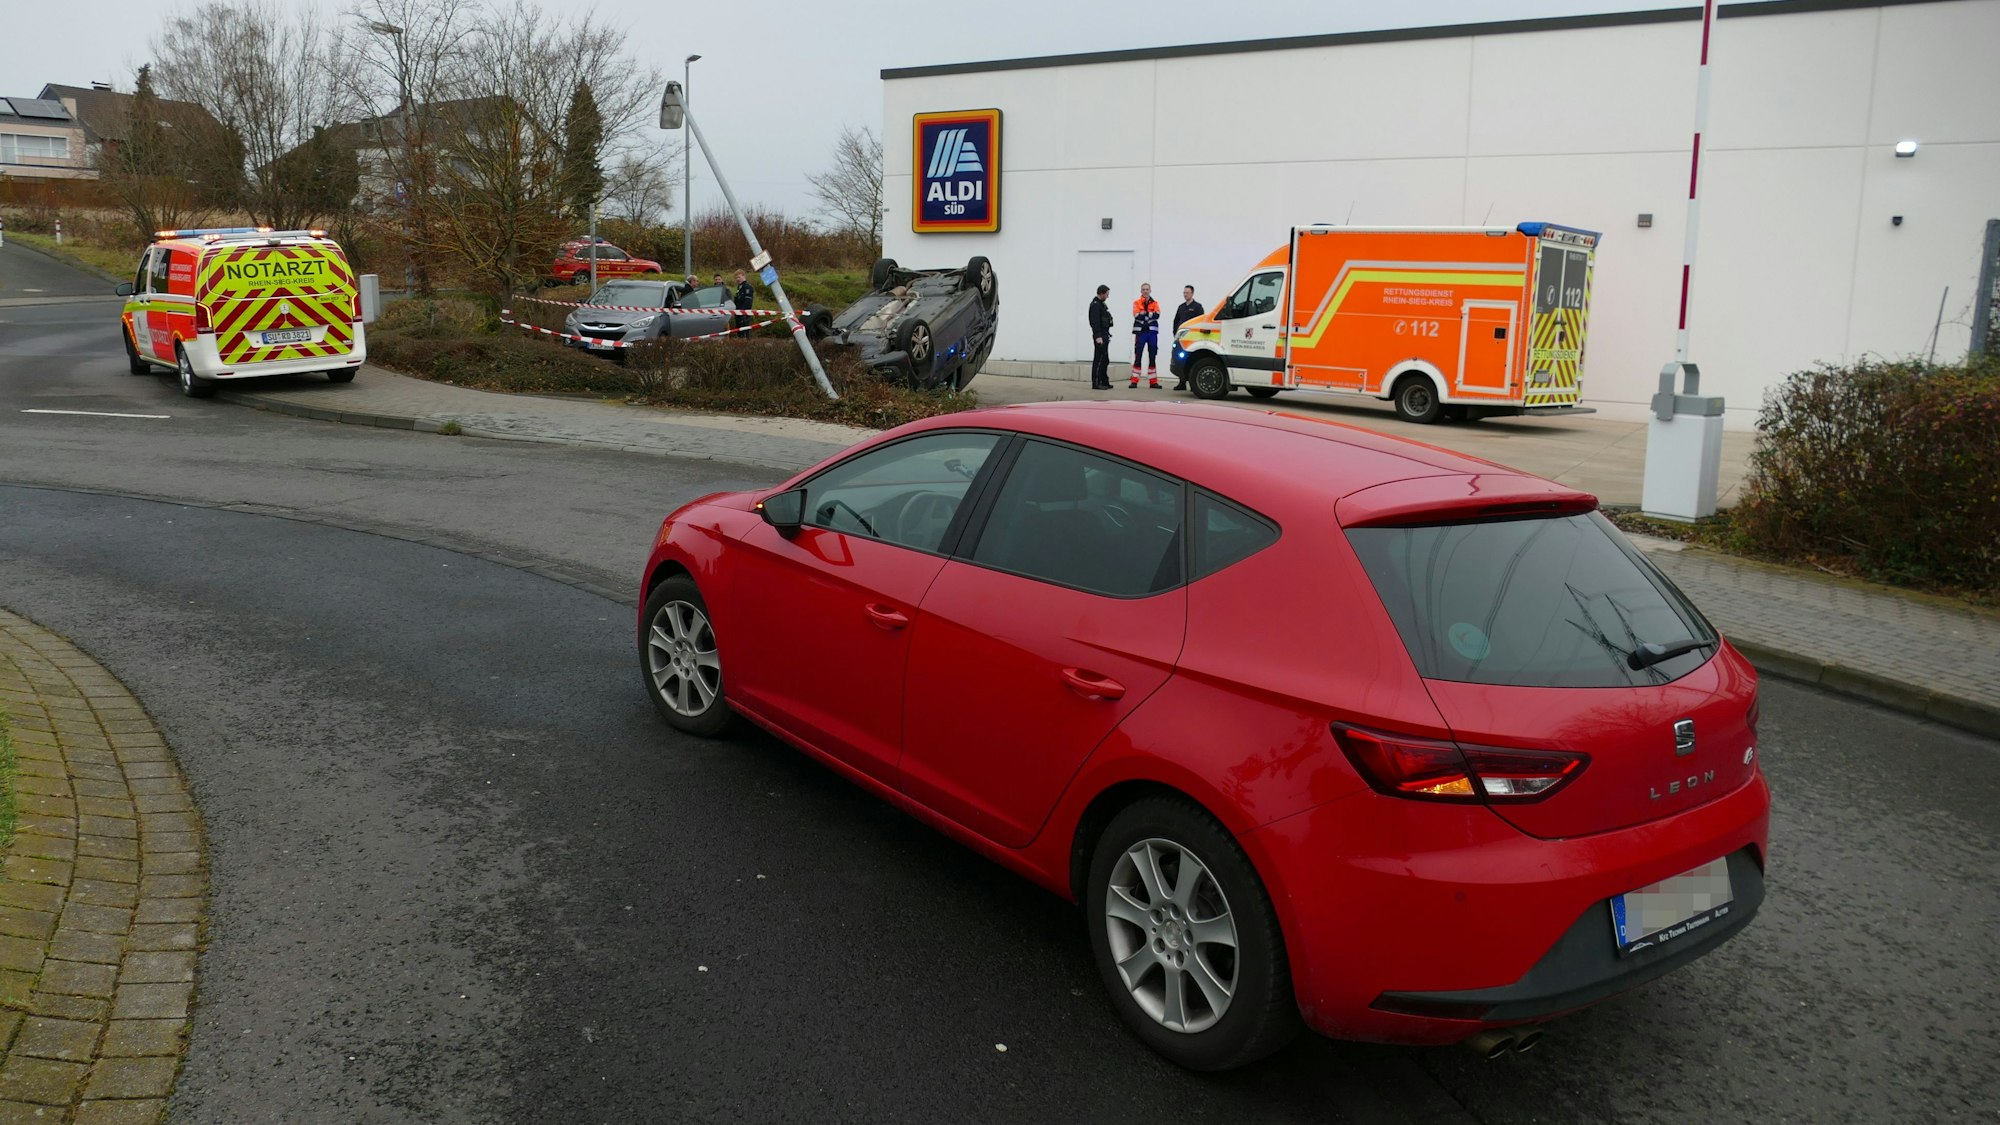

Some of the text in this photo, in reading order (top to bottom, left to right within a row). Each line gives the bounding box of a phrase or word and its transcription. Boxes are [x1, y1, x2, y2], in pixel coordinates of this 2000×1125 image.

[927, 180, 982, 202] ALDI
[944, 202, 965, 215] SÜD
[227, 260, 325, 280] NOTARZT
[248, 277, 315, 287] RHEIN-SIEG-KREIS
[1384, 287, 1454, 297] RETTUNGSDIENST
[1565, 286, 1582, 307] 112
[1383, 296, 1454, 306] RHEIN-SIEG-KREIS
[1410, 319, 1440, 337] 112
[267, 332, 278, 341] SU
[281, 331, 291, 340] RD
[1650, 769, 1715, 799] LEON
